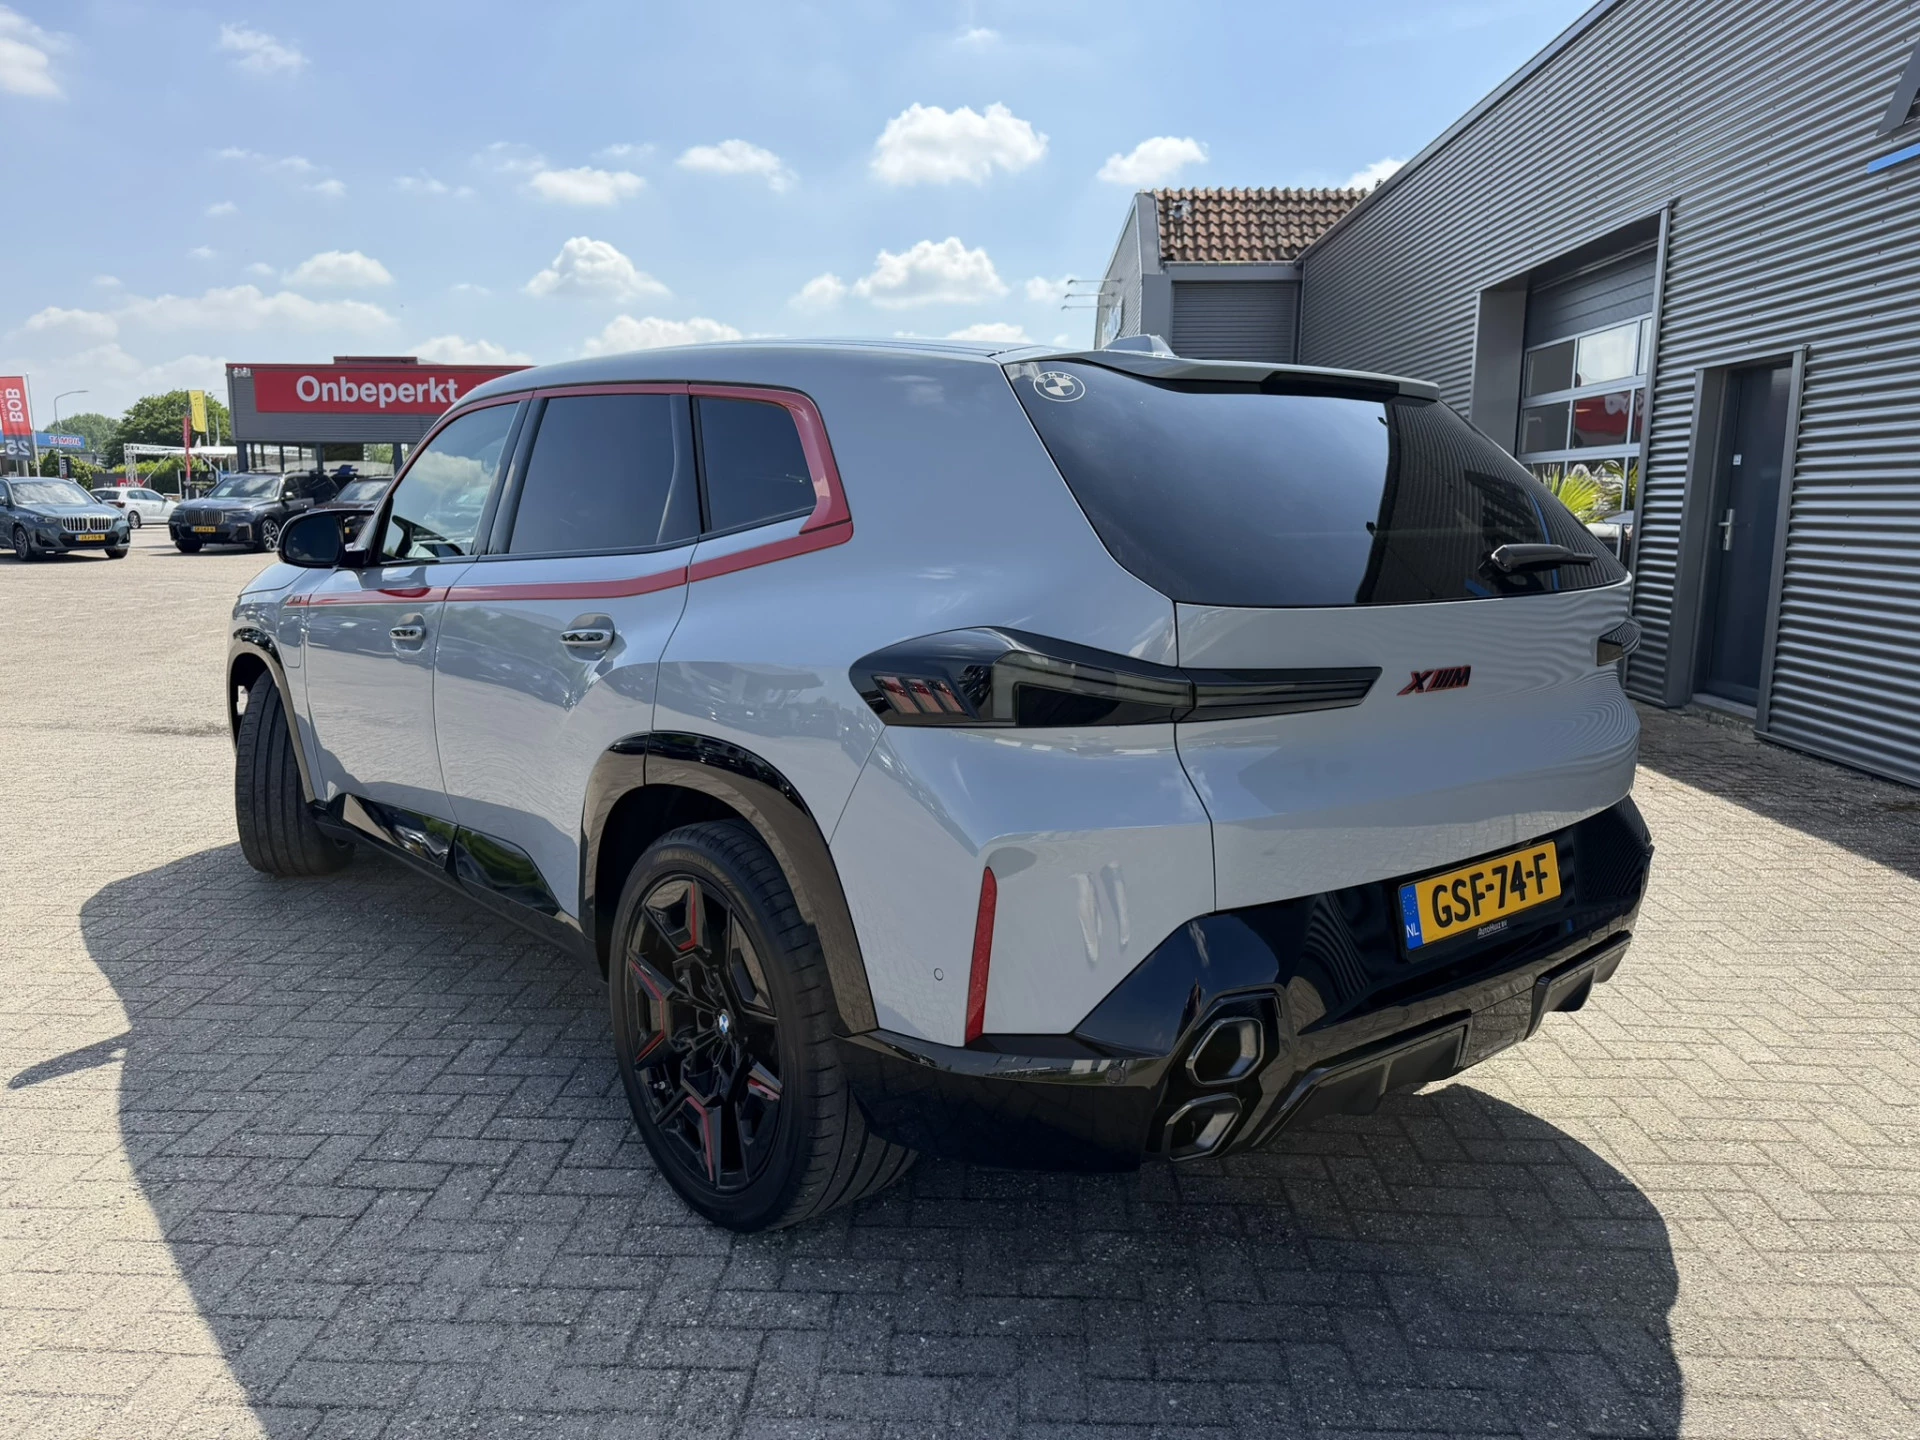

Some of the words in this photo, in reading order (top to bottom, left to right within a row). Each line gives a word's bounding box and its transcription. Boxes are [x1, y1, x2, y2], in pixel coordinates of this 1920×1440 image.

[1037, 373, 1072, 383] BMW
[296, 376, 458, 408] Onbeperkt
[49, 436, 81, 445] TAMOIL
[1432, 853, 1548, 928] GSF-74-F
[1406, 923, 1419, 937] NL
